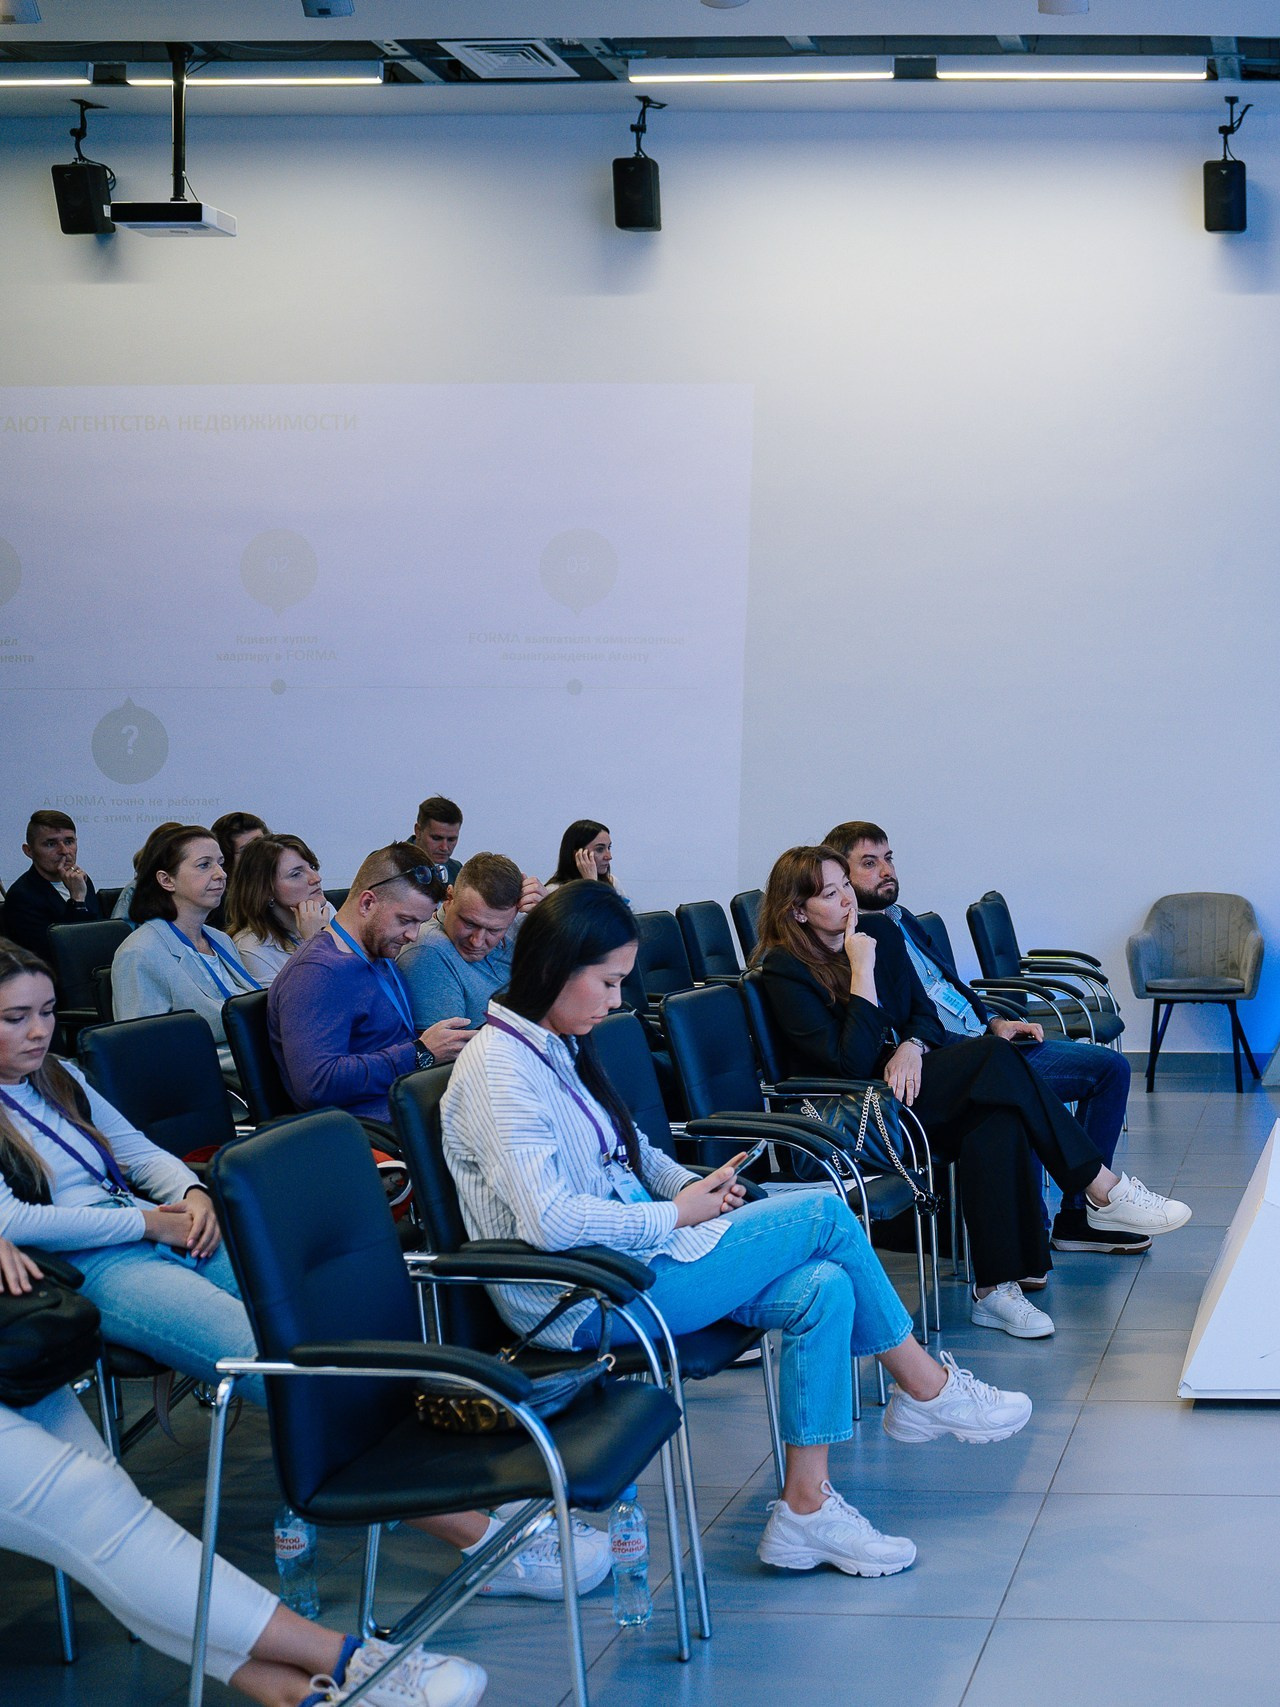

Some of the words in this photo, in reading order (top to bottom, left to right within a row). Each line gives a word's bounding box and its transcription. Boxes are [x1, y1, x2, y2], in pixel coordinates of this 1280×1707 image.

[0, 415, 51, 433] АЮТ
[57, 414, 171, 433] АГЕНТСТВА
[178, 413, 357, 434] НЕДВИЖИМОСТИ
